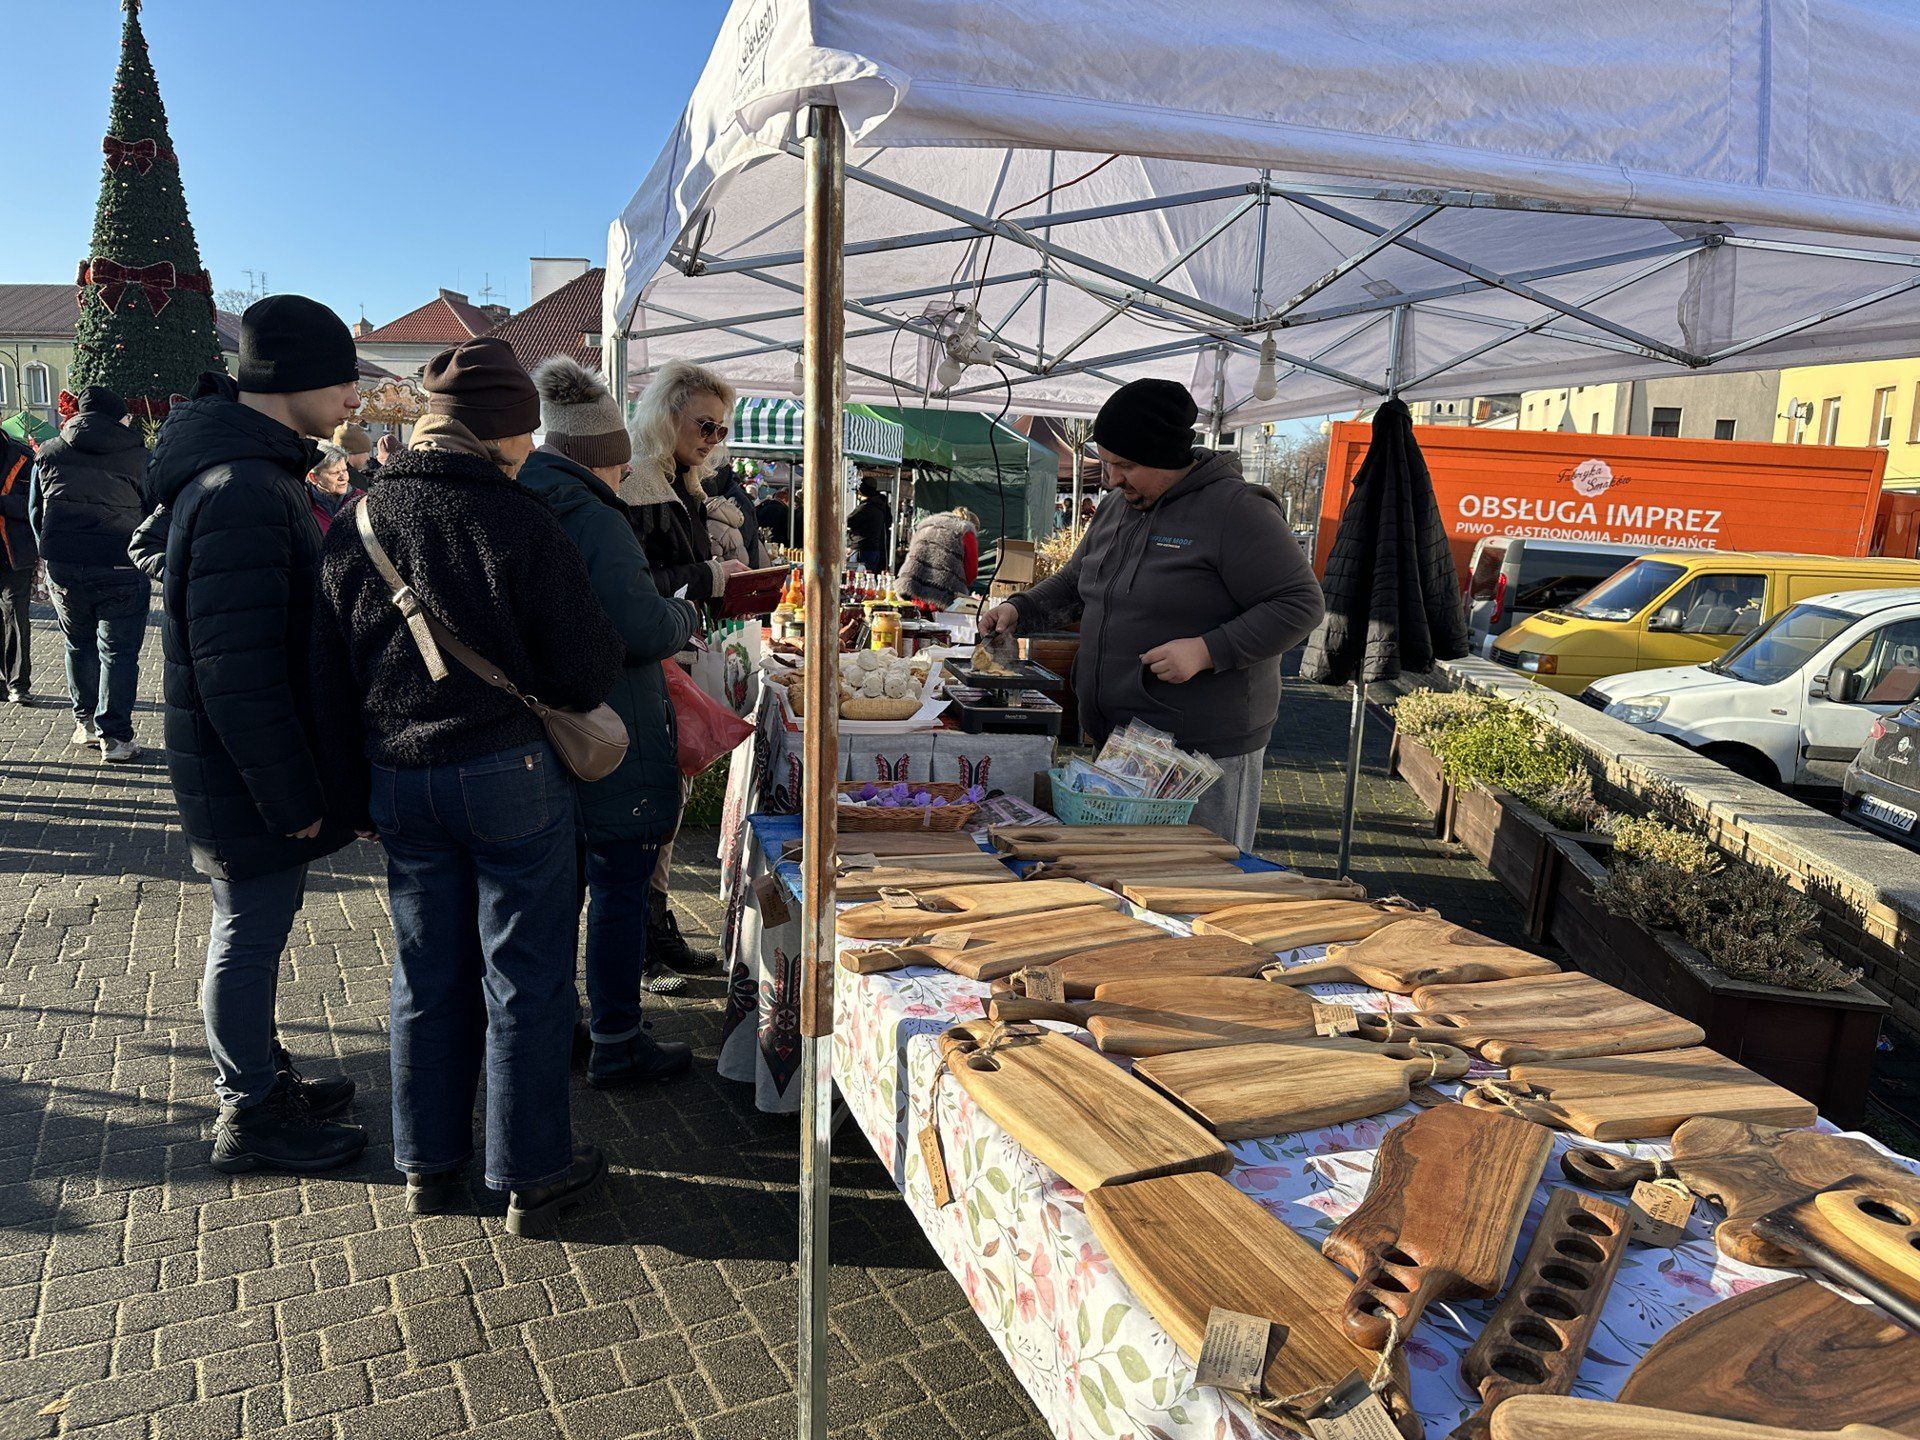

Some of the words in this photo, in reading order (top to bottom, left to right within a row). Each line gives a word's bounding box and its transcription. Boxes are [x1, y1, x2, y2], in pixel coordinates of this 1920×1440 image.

[1458, 494, 1597, 526] OBSŁUGA
[1605, 502, 1722, 533] IMPREZ
[1455, 521, 1494, 535] PIWO
[1503, 525, 1611, 542] GASTRONOMIA
[1621, 532, 1717, 551] DMUCHAŃCE
